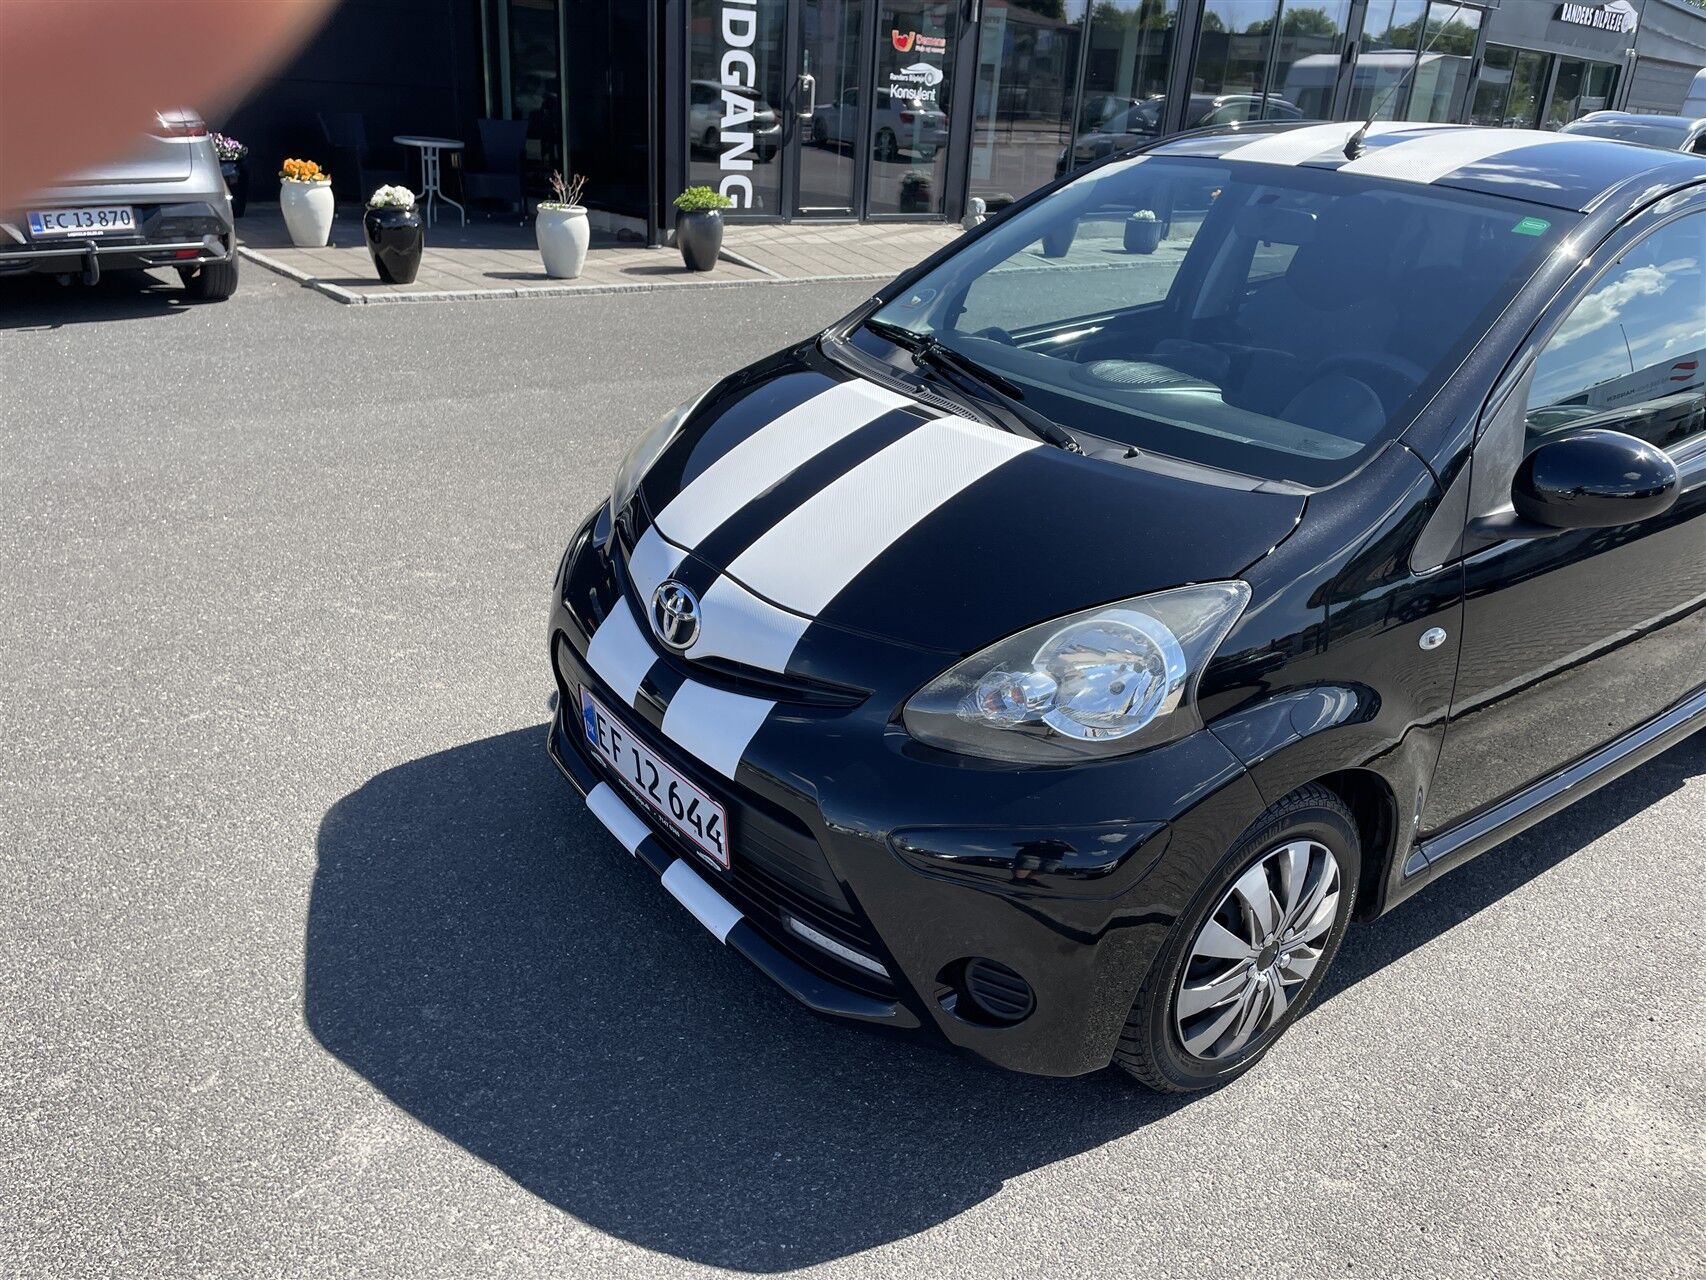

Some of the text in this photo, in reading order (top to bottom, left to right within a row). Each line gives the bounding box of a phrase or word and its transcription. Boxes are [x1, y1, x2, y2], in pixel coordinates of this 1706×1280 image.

[1561, 3, 1622, 31] RANDERS BILPLEJE
[719, 0, 757, 208] DGANG
[890, 83, 936, 101] Konsulent
[43, 210, 131, 230] EC 13 870
[597, 713, 622, 763] EF
[632, 748, 662, 804] 12
[669, 781, 723, 855] 644
